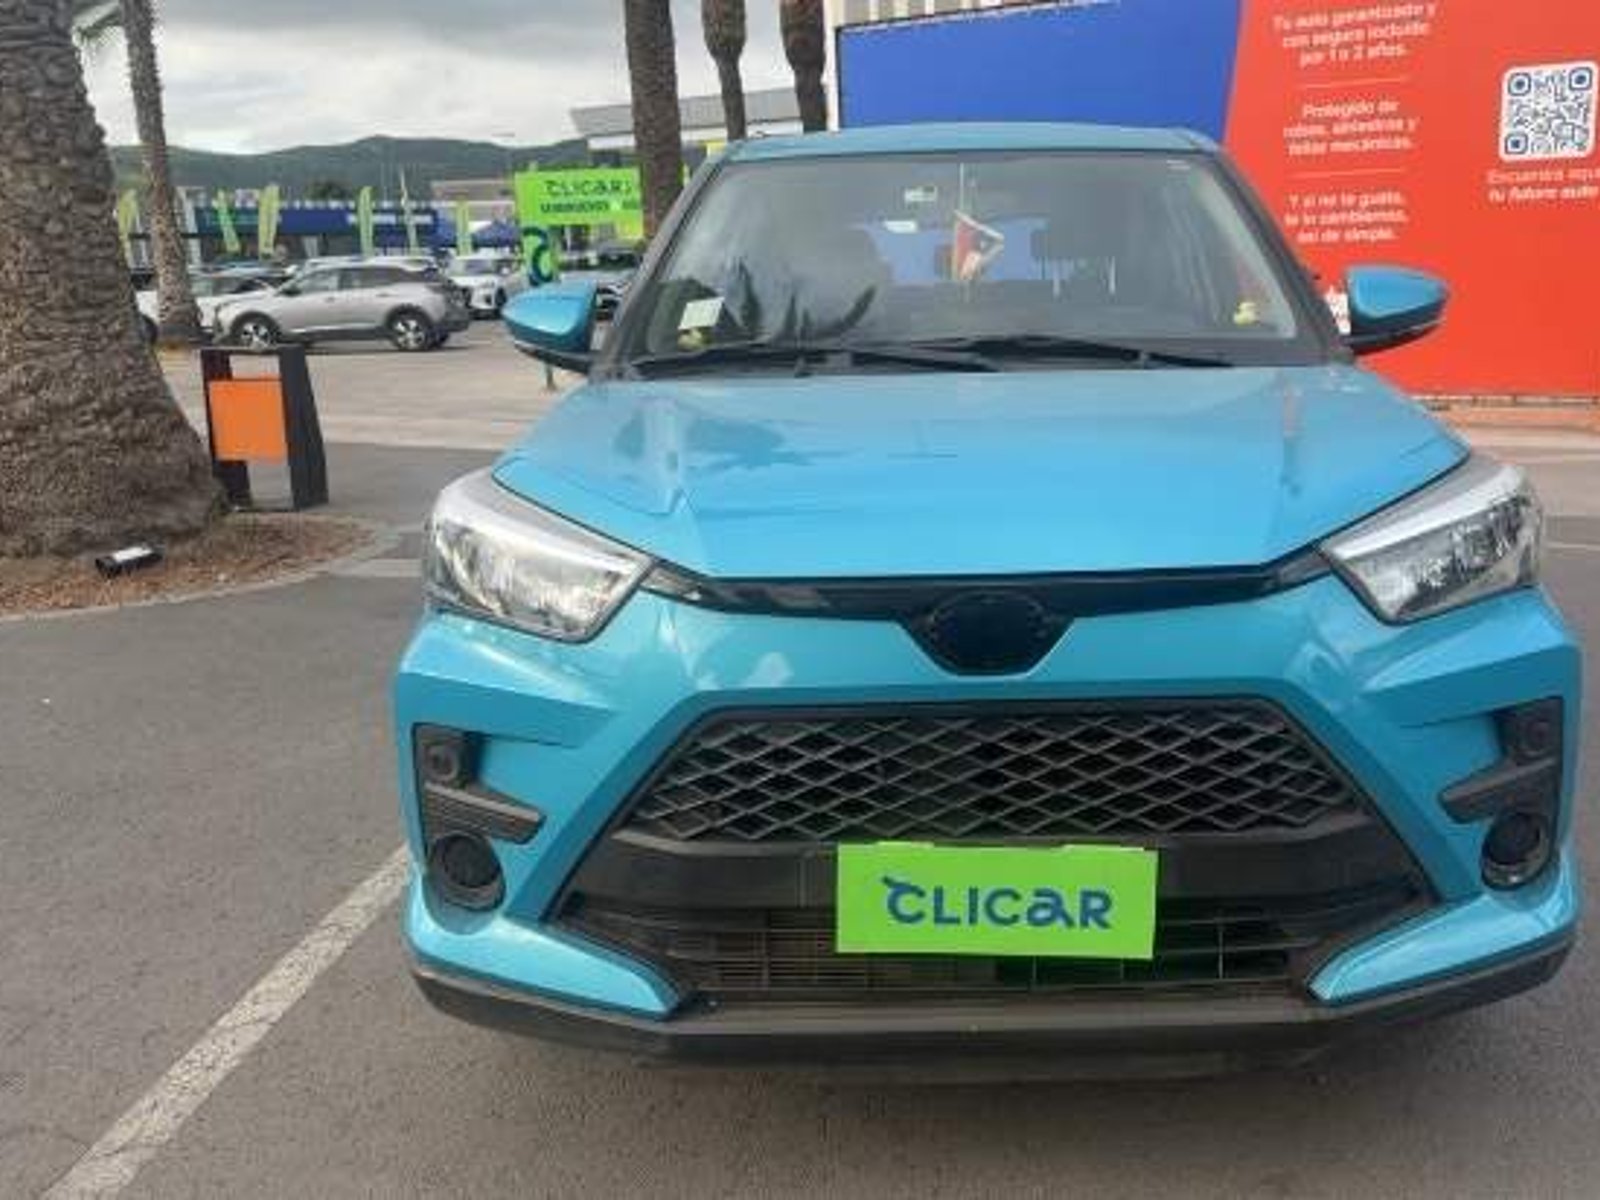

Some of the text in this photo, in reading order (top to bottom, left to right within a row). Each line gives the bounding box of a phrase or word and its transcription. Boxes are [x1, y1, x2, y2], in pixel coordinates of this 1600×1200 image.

[1282, 21, 1430, 48] con seguro incluido
[1300, 51, 1325, 67] por
[1302, 101, 1399, 119] Protegido de
[1487, 168, 1563, 184] Encuentra
